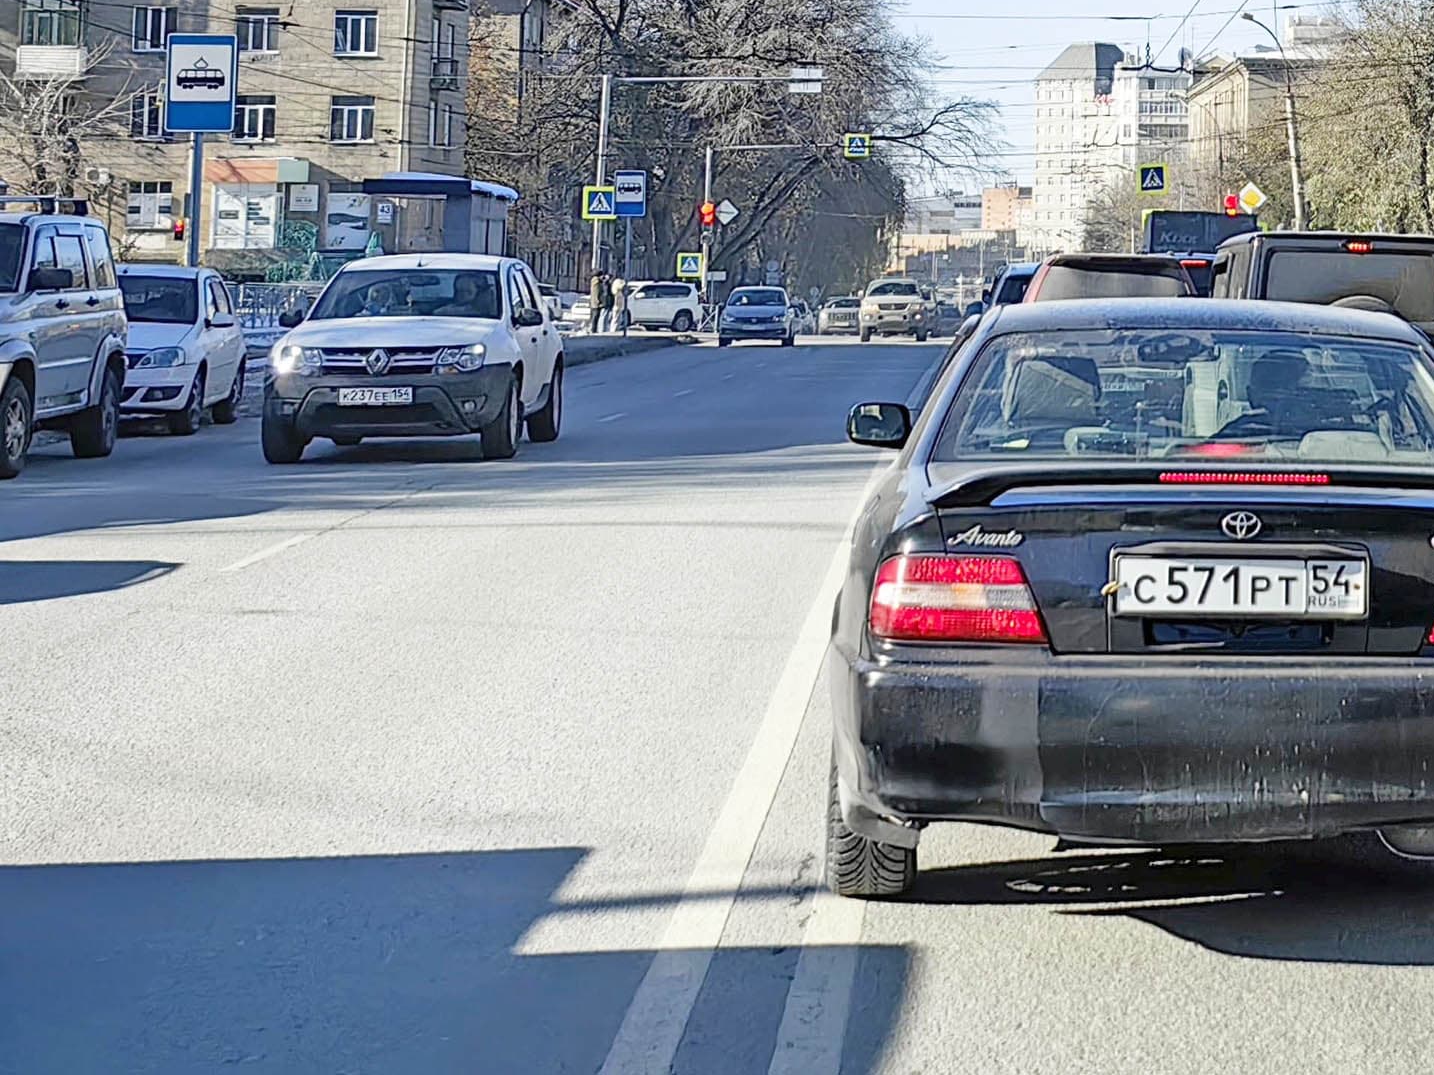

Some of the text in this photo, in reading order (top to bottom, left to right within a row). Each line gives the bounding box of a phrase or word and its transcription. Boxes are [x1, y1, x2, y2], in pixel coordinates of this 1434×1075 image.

[947, 524, 1024, 546] Avante
[1311, 564, 1351, 596] 54
[1308, 595, 1337, 607] RUS
